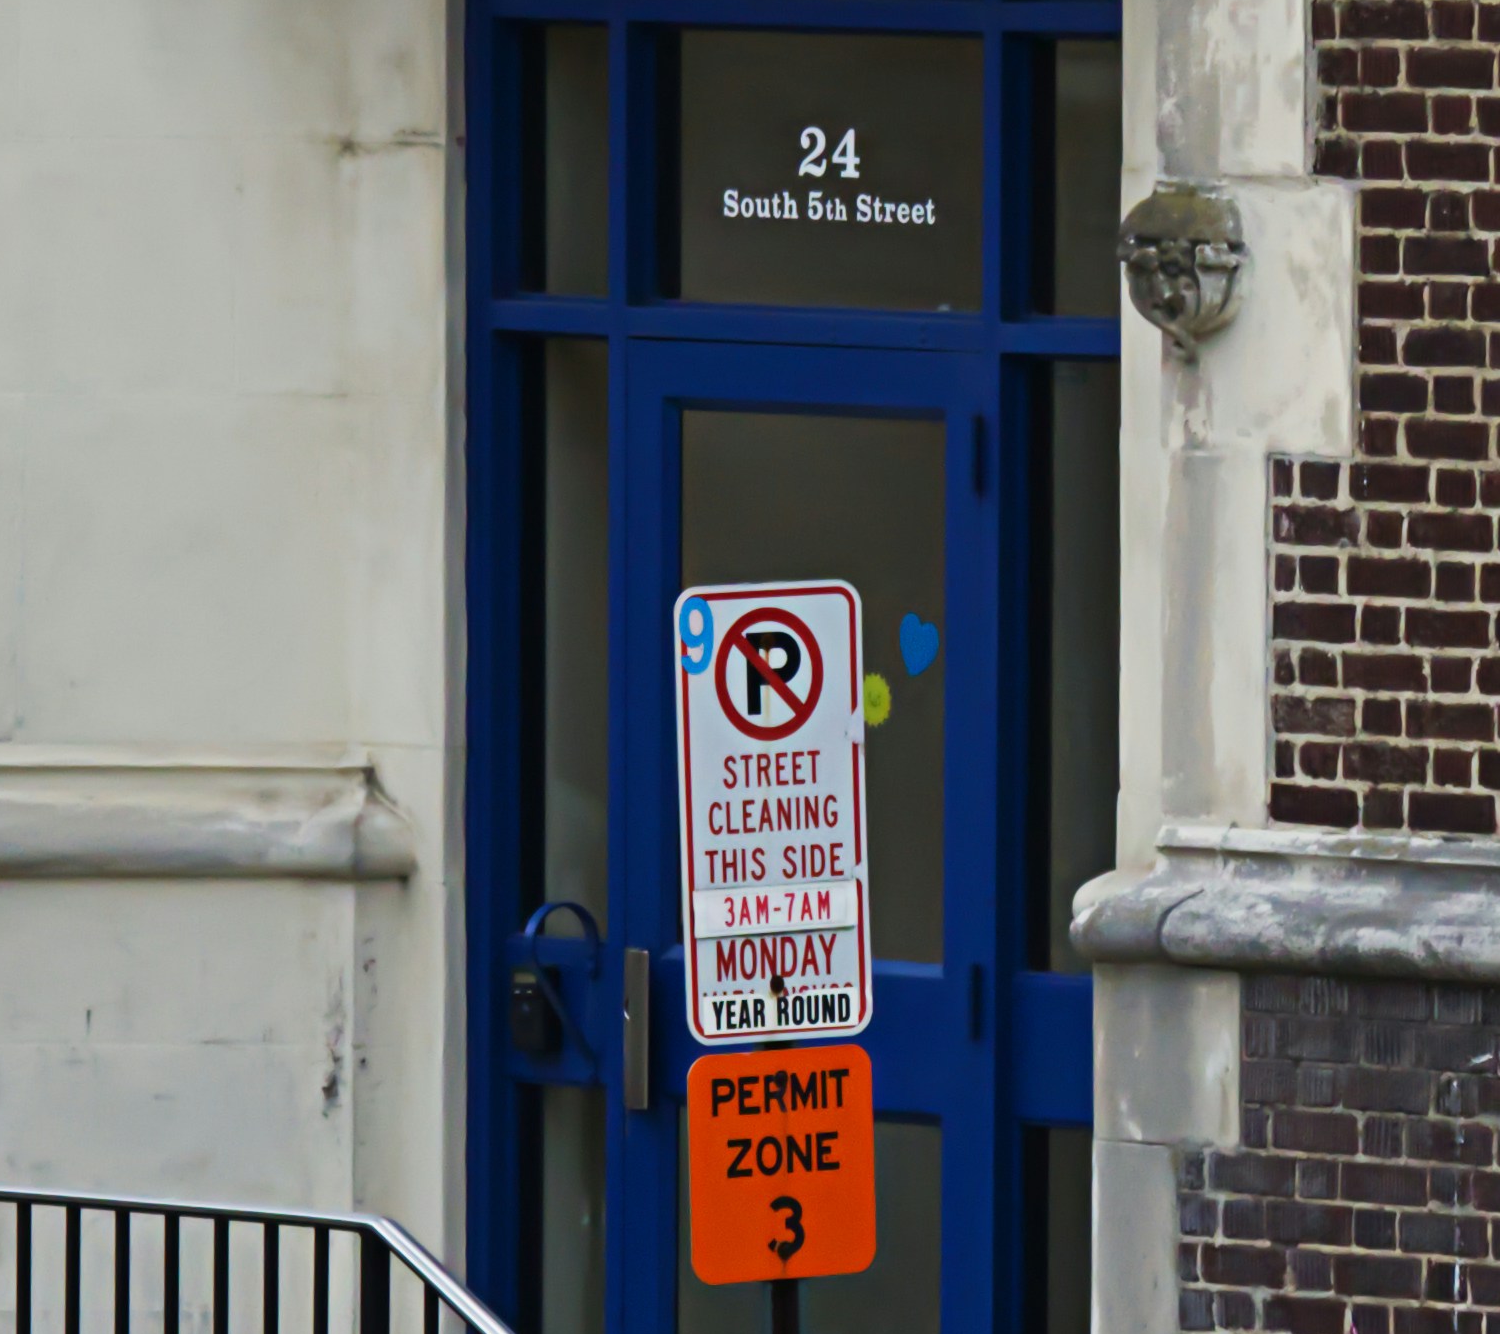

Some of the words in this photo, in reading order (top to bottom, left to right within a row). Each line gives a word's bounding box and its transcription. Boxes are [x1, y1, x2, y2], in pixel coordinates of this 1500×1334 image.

[798, 125, 861, 179] 24
[722, 188, 799, 219] South
[807, 190, 848, 221] 5th
[855, 193, 936, 225] Street
[678, 596, 715, 676] 9
[723, 750, 821, 790] STREET
[708, 794, 839, 836] CLEANING
[705, 846, 766, 884] THIS
[782, 842, 845, 880] SIDE
[724, 889, 831, 928] 3AM-7AM
[715, 933, 837, 983] MONDAY
[712, 998, 766, 1031] YEAR
[776, 993, 851, 1027] ROUND
[711, 1068, 850, 1117] PERMIT
[726, 1131, 841, 1179] ZONE
[767, 1195, 806, 1261] 3
